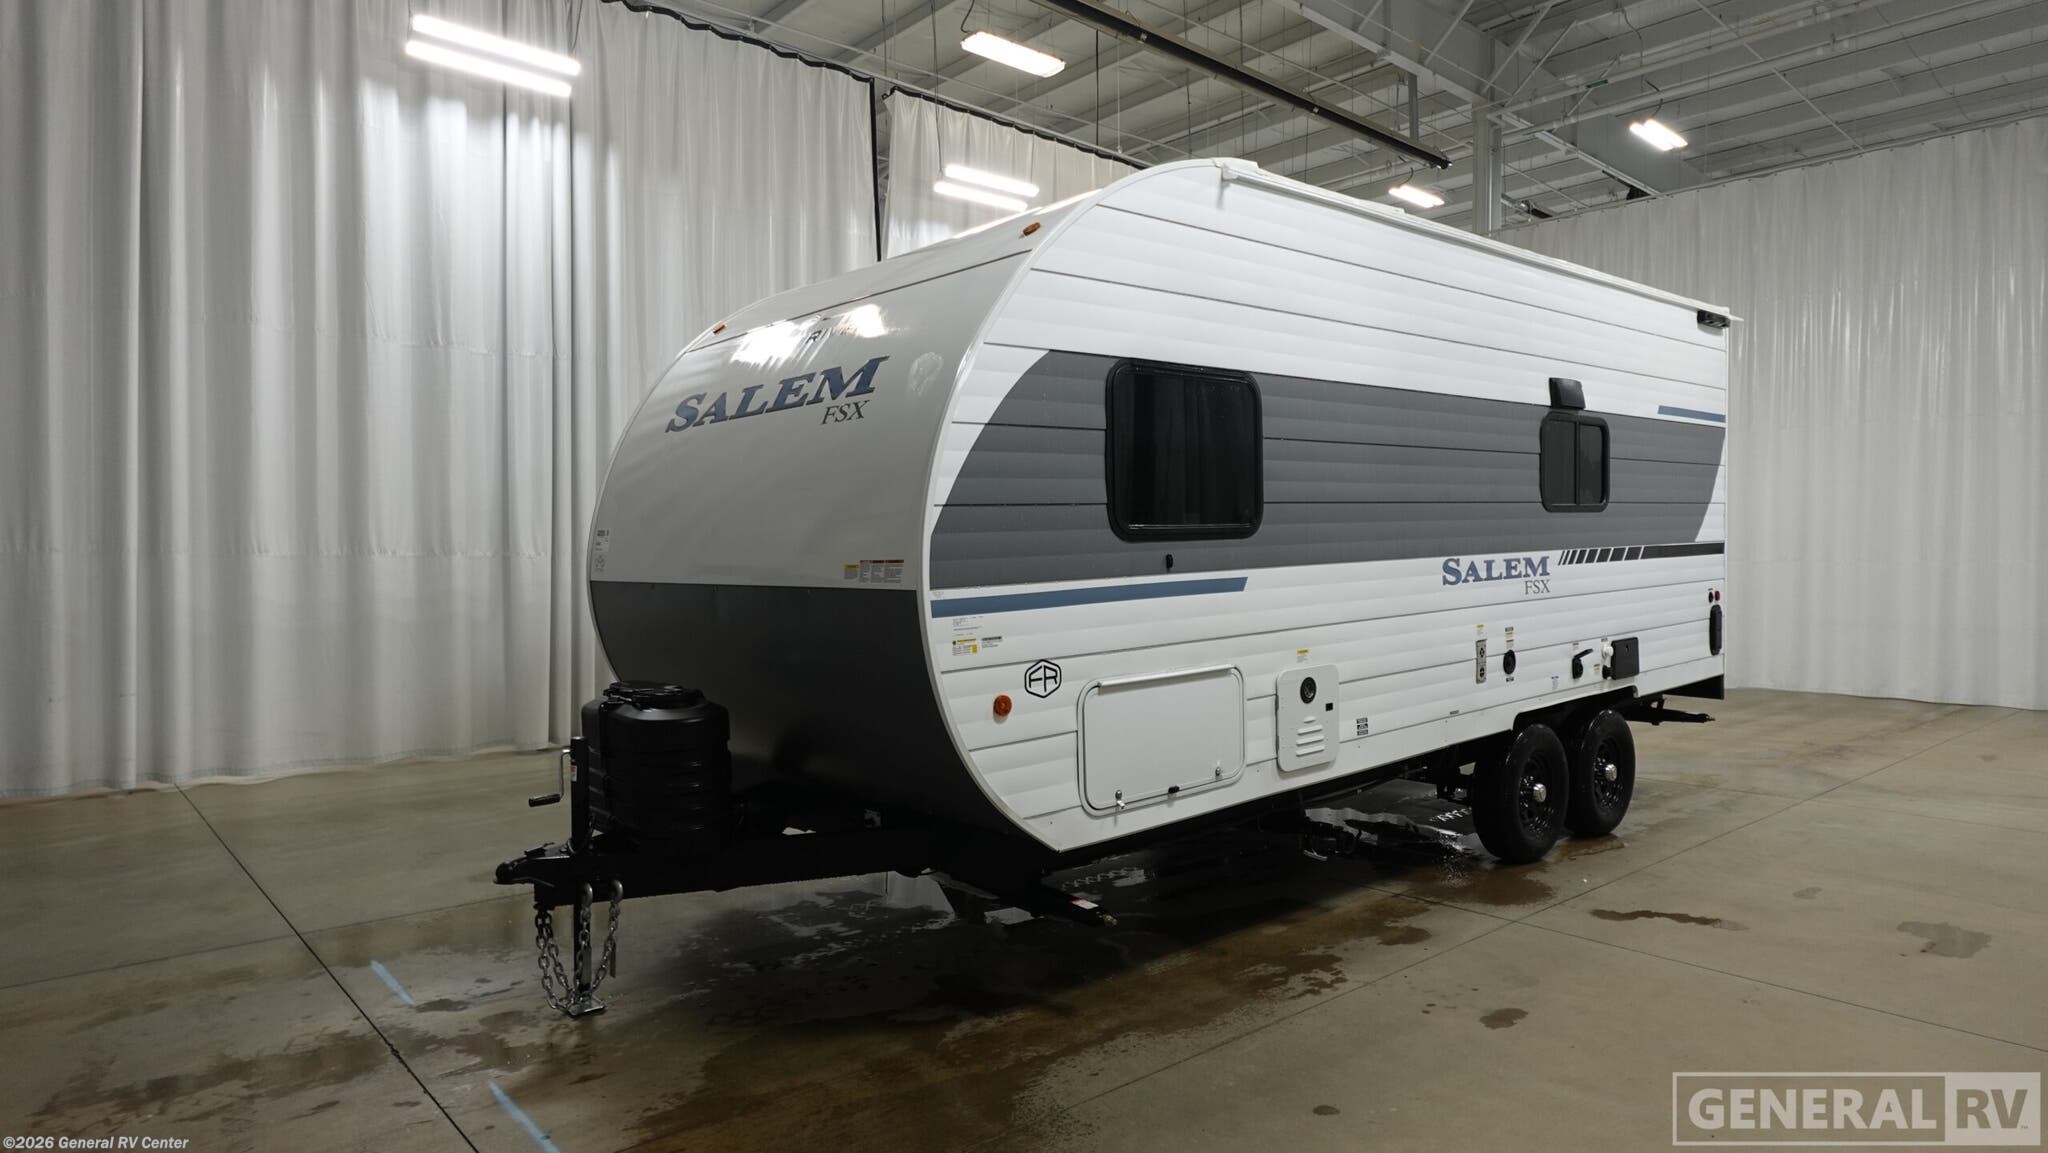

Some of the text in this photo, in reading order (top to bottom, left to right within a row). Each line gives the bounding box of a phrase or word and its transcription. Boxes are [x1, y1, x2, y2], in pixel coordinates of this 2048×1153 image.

[665, 355, 890, 433] SALEM
[821, 400, 870, 425] FSX
[1442, 556, 1550, 586] SALEM
[1524, 579, 1550, 595] FSX
